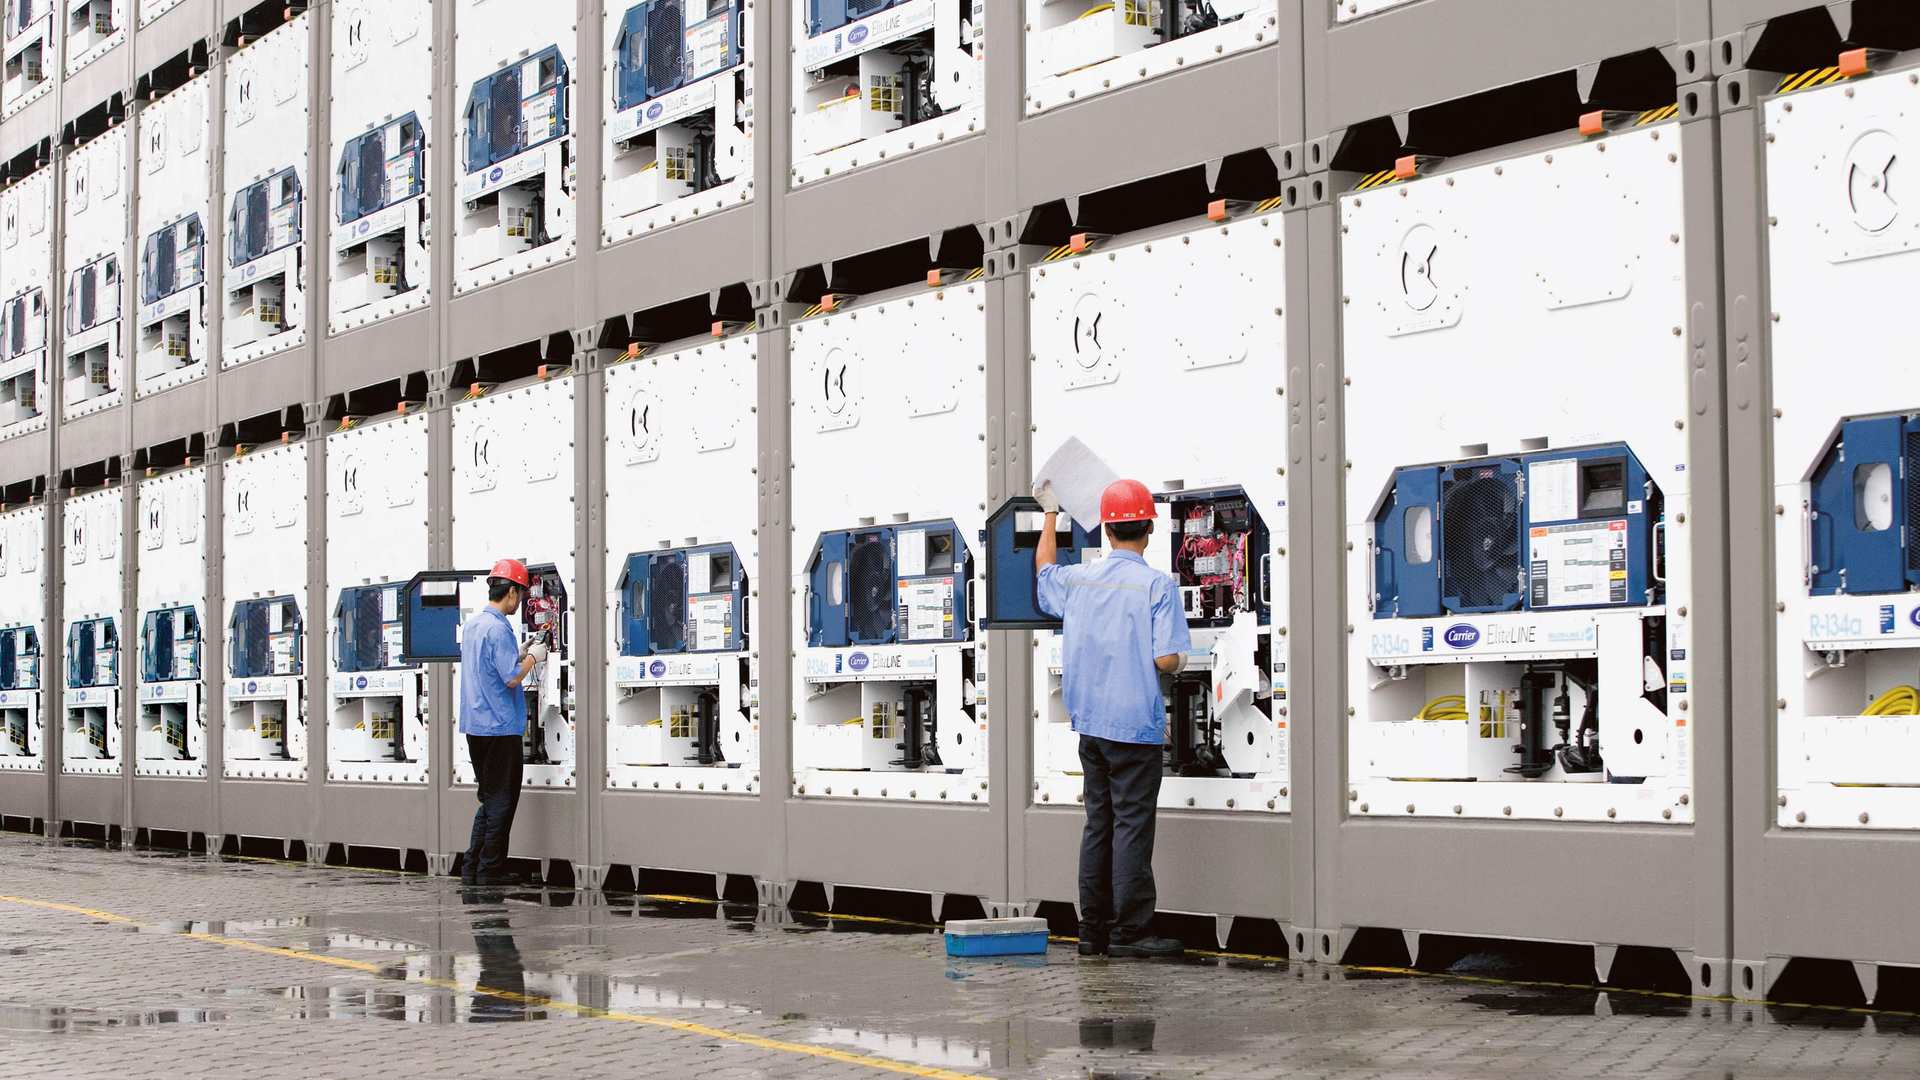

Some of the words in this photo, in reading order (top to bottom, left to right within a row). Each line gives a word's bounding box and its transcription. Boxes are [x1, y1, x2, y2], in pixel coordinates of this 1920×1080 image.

[1447, 628, 1477, 643] Carrier
[1486, 624, 1536, 645] EliteLINE
[1810, 613, 1861, 637] R-134a
[1371, 634, 1410, 655] R-134a
[1051, 647, 1063, 664] R-1
